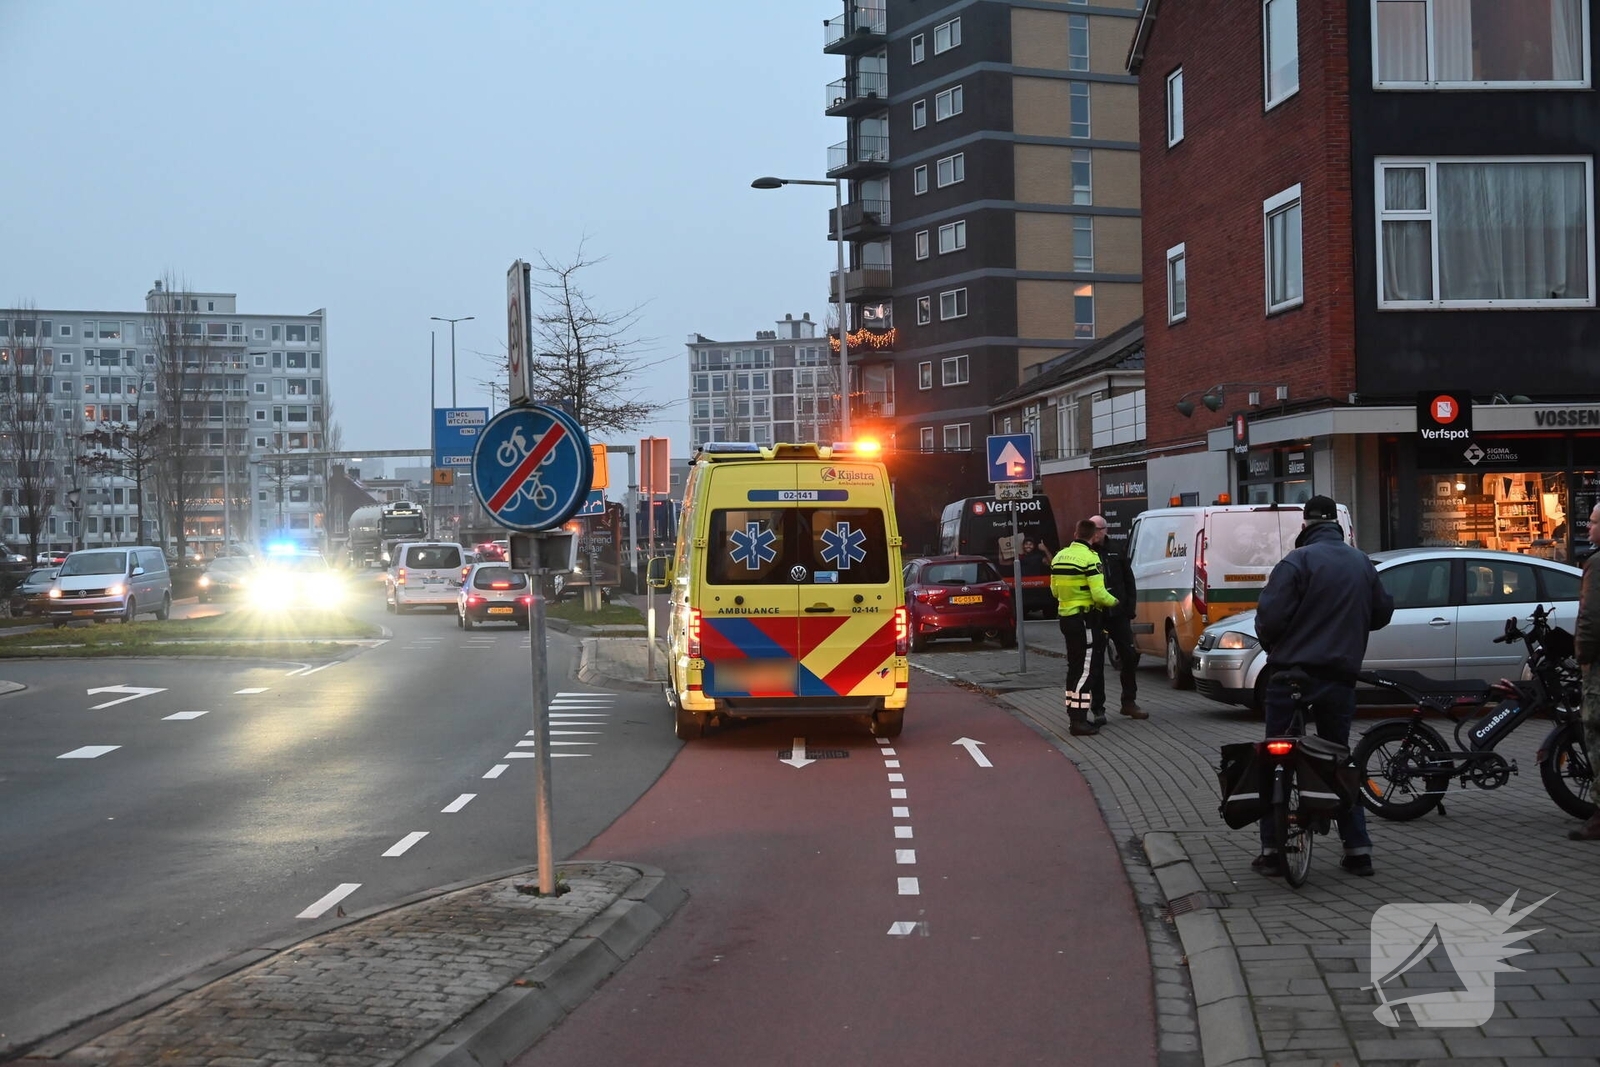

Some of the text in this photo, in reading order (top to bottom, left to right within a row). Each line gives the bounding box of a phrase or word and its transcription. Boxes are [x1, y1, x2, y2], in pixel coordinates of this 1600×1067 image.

[1535, 410, 1600, 426] VOSSEN
[1421, 429, 1470, 441] Verfspot
[838, 470, 874, 481] Kijlstra
[783, 491, 812, 499] 02-141
[985, 500, 1042, 513] Verfspot
[1475, 708, 1511, 738] CrossBoss
